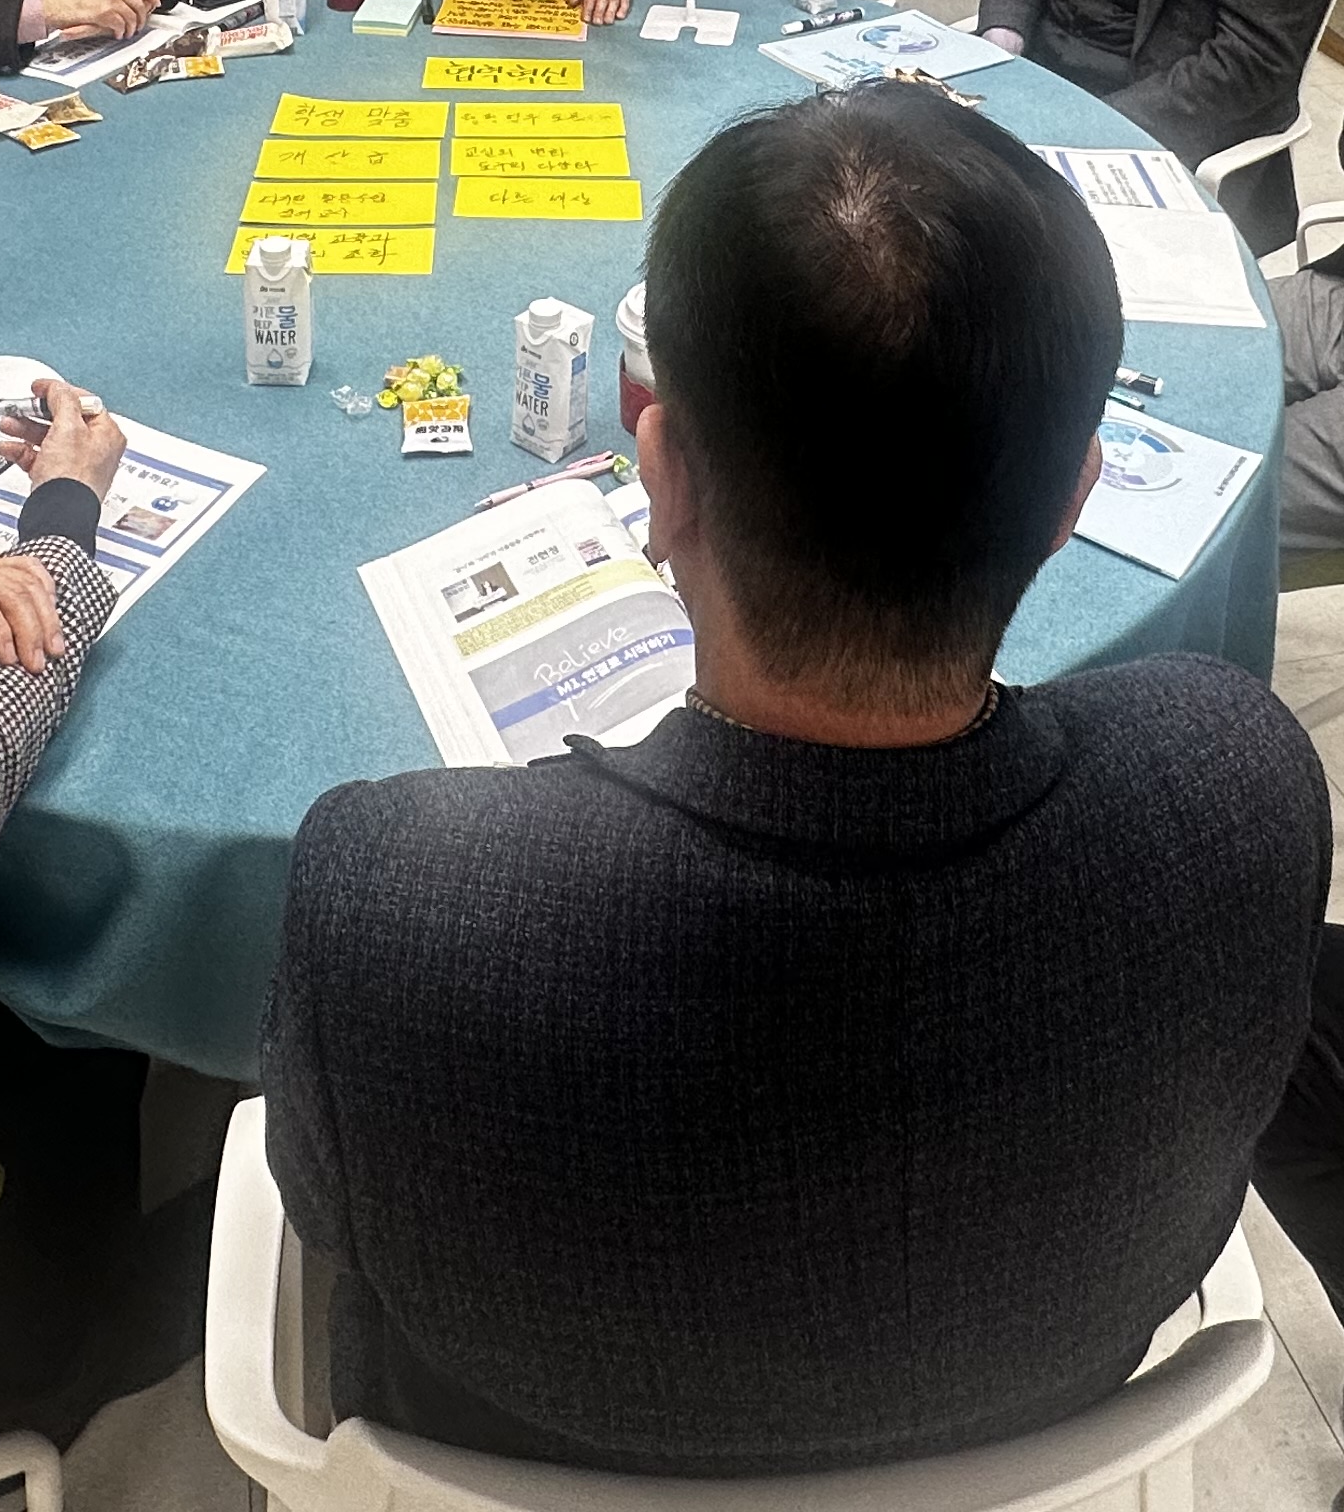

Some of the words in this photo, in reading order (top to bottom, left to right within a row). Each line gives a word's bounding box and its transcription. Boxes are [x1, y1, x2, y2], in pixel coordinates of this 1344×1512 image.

[277, 305, 298, 330] 물
[255, 329, 296, 346] WATER
[532, 372, 552, 400] 물
[533, 625, 628, 687] Believe
[623, 632, 676, 661] 시작하기
